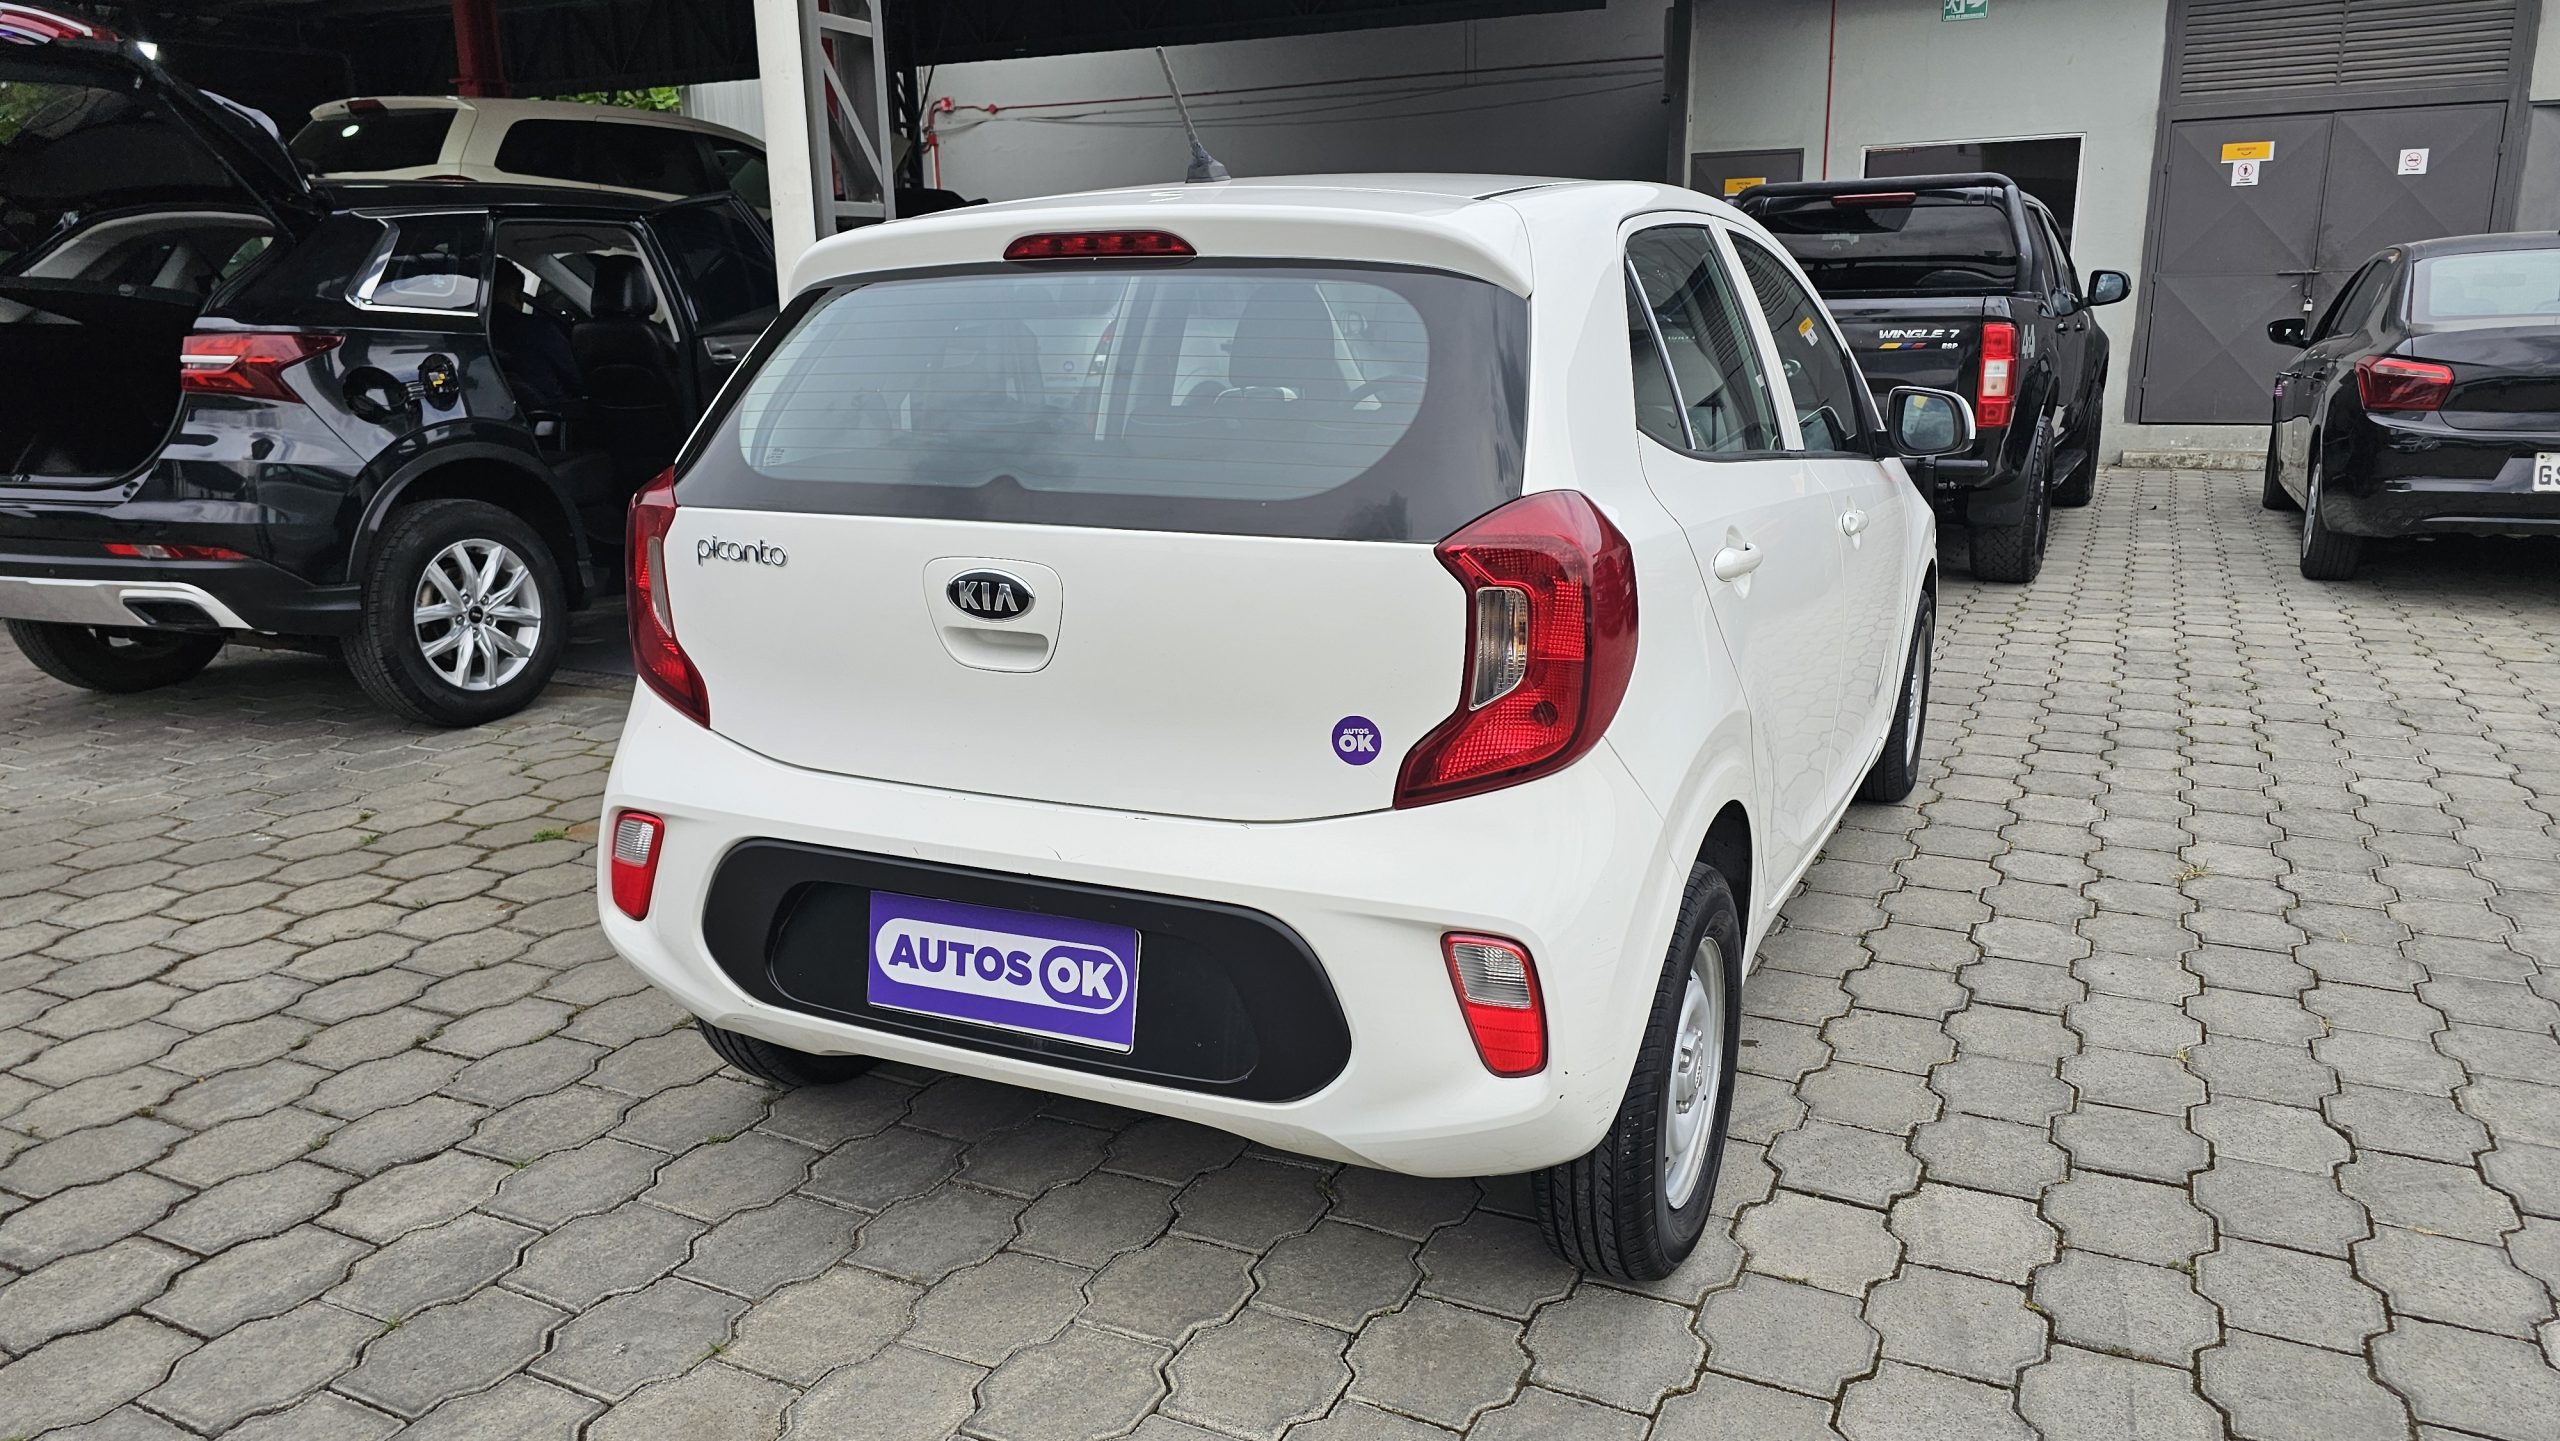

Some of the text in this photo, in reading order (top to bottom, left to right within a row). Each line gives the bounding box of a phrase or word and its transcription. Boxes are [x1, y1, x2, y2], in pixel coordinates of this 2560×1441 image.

[1879, 329, 1960, 339] WINGLE 7
[697, 534, 788, 567] picanto
[958, 580, 1019, 612] KIA
[1339, 735, 1375, 752] OK
[888, 934, 1114, 1000] AUTOS OK
